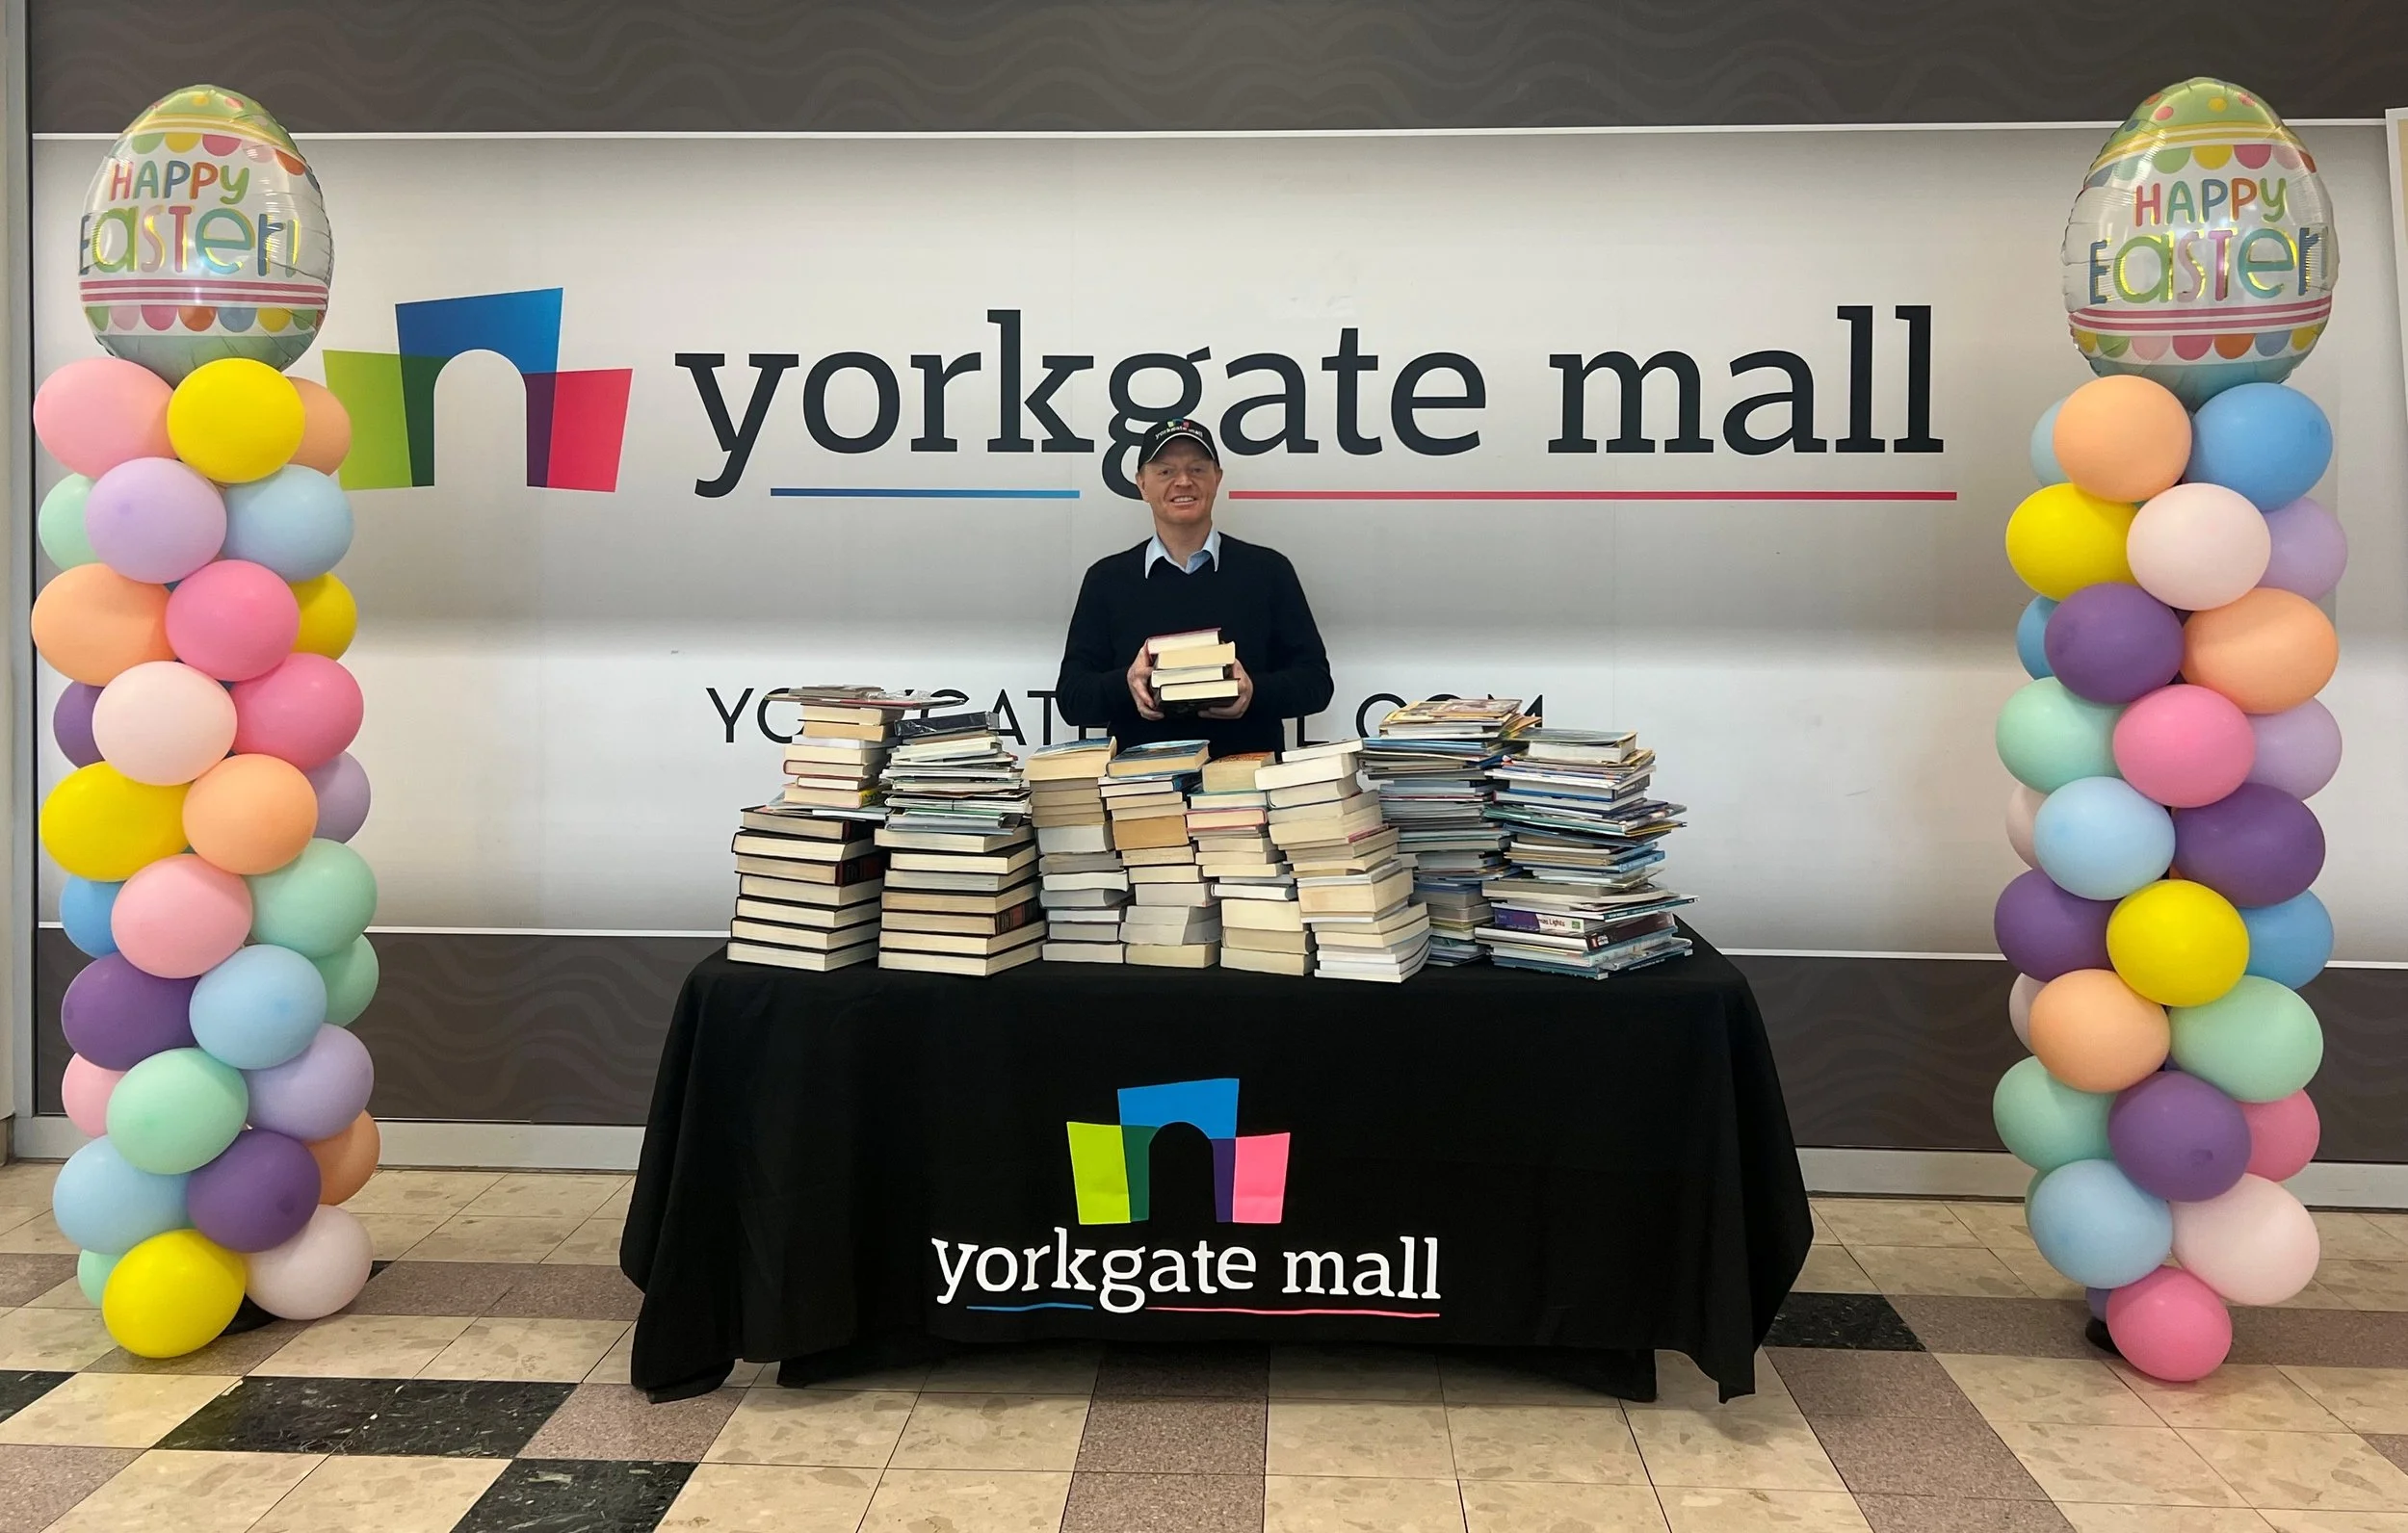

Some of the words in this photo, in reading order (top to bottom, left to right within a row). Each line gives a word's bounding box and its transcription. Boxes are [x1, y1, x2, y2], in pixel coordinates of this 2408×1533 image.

[109, 160, 249, 204] HAPPY
[2133, 177, 2287, 227] HAPPY
[675, 309, 1486, 501] yorkgate
[1547, 305, 1944, 455] mall
[931, 1227, 1256, 1313] yorkgate
[1282, 1236, 1441, 1300] mall
